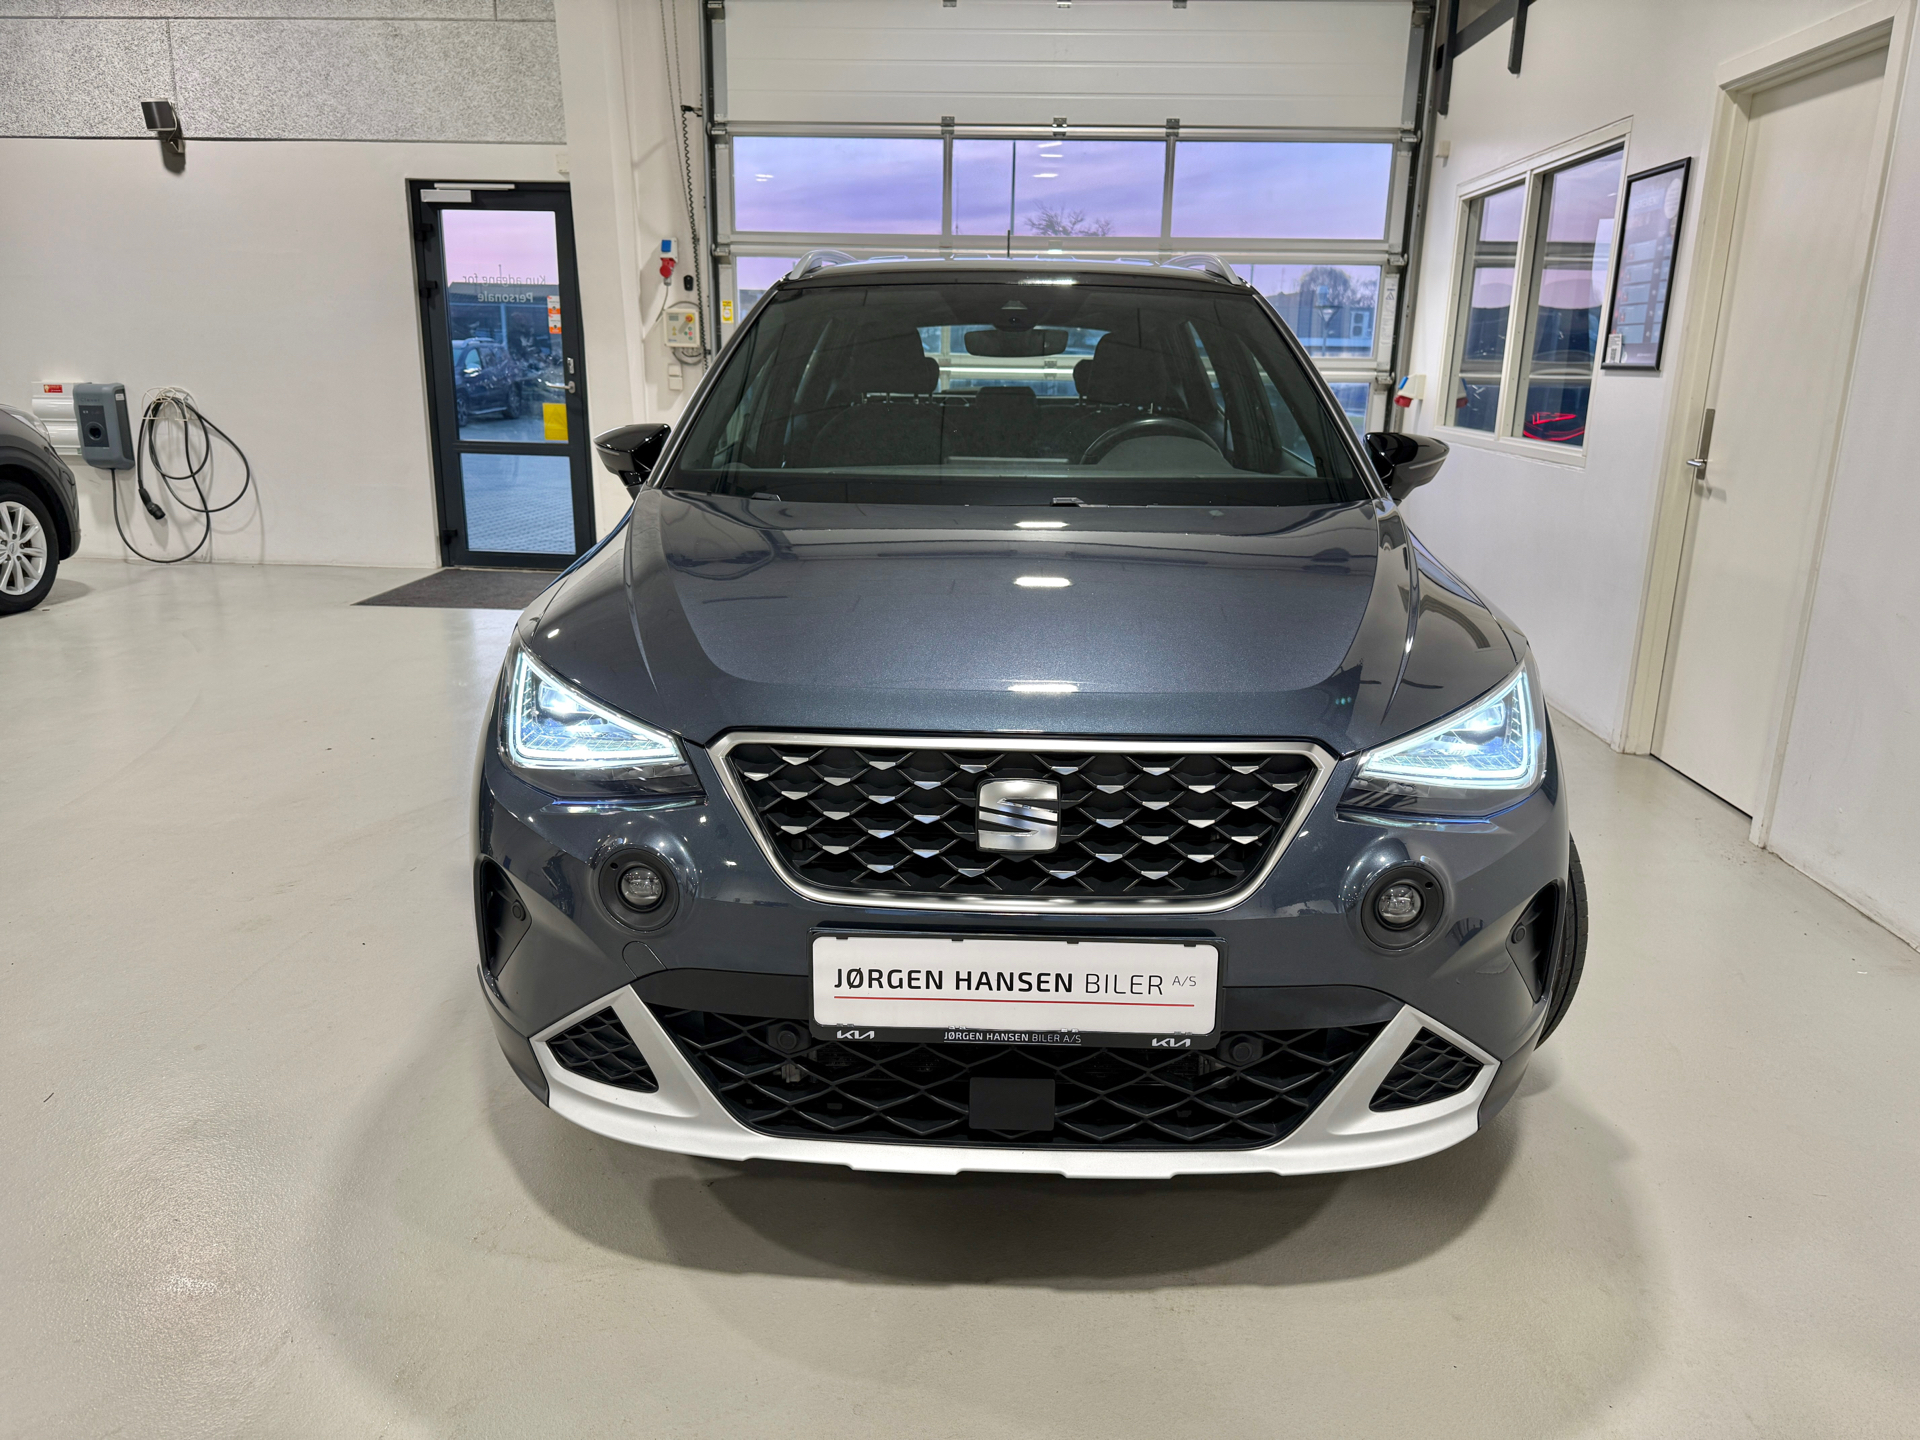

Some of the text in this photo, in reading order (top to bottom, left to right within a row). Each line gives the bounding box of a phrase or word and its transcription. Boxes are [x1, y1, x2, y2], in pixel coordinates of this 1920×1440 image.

[834, 967, 1197, 995] JØRGEN HANSEN BILER A/S
[944, 1031, 1082, 1044] JØRGEN HANSEN BILER A/S
